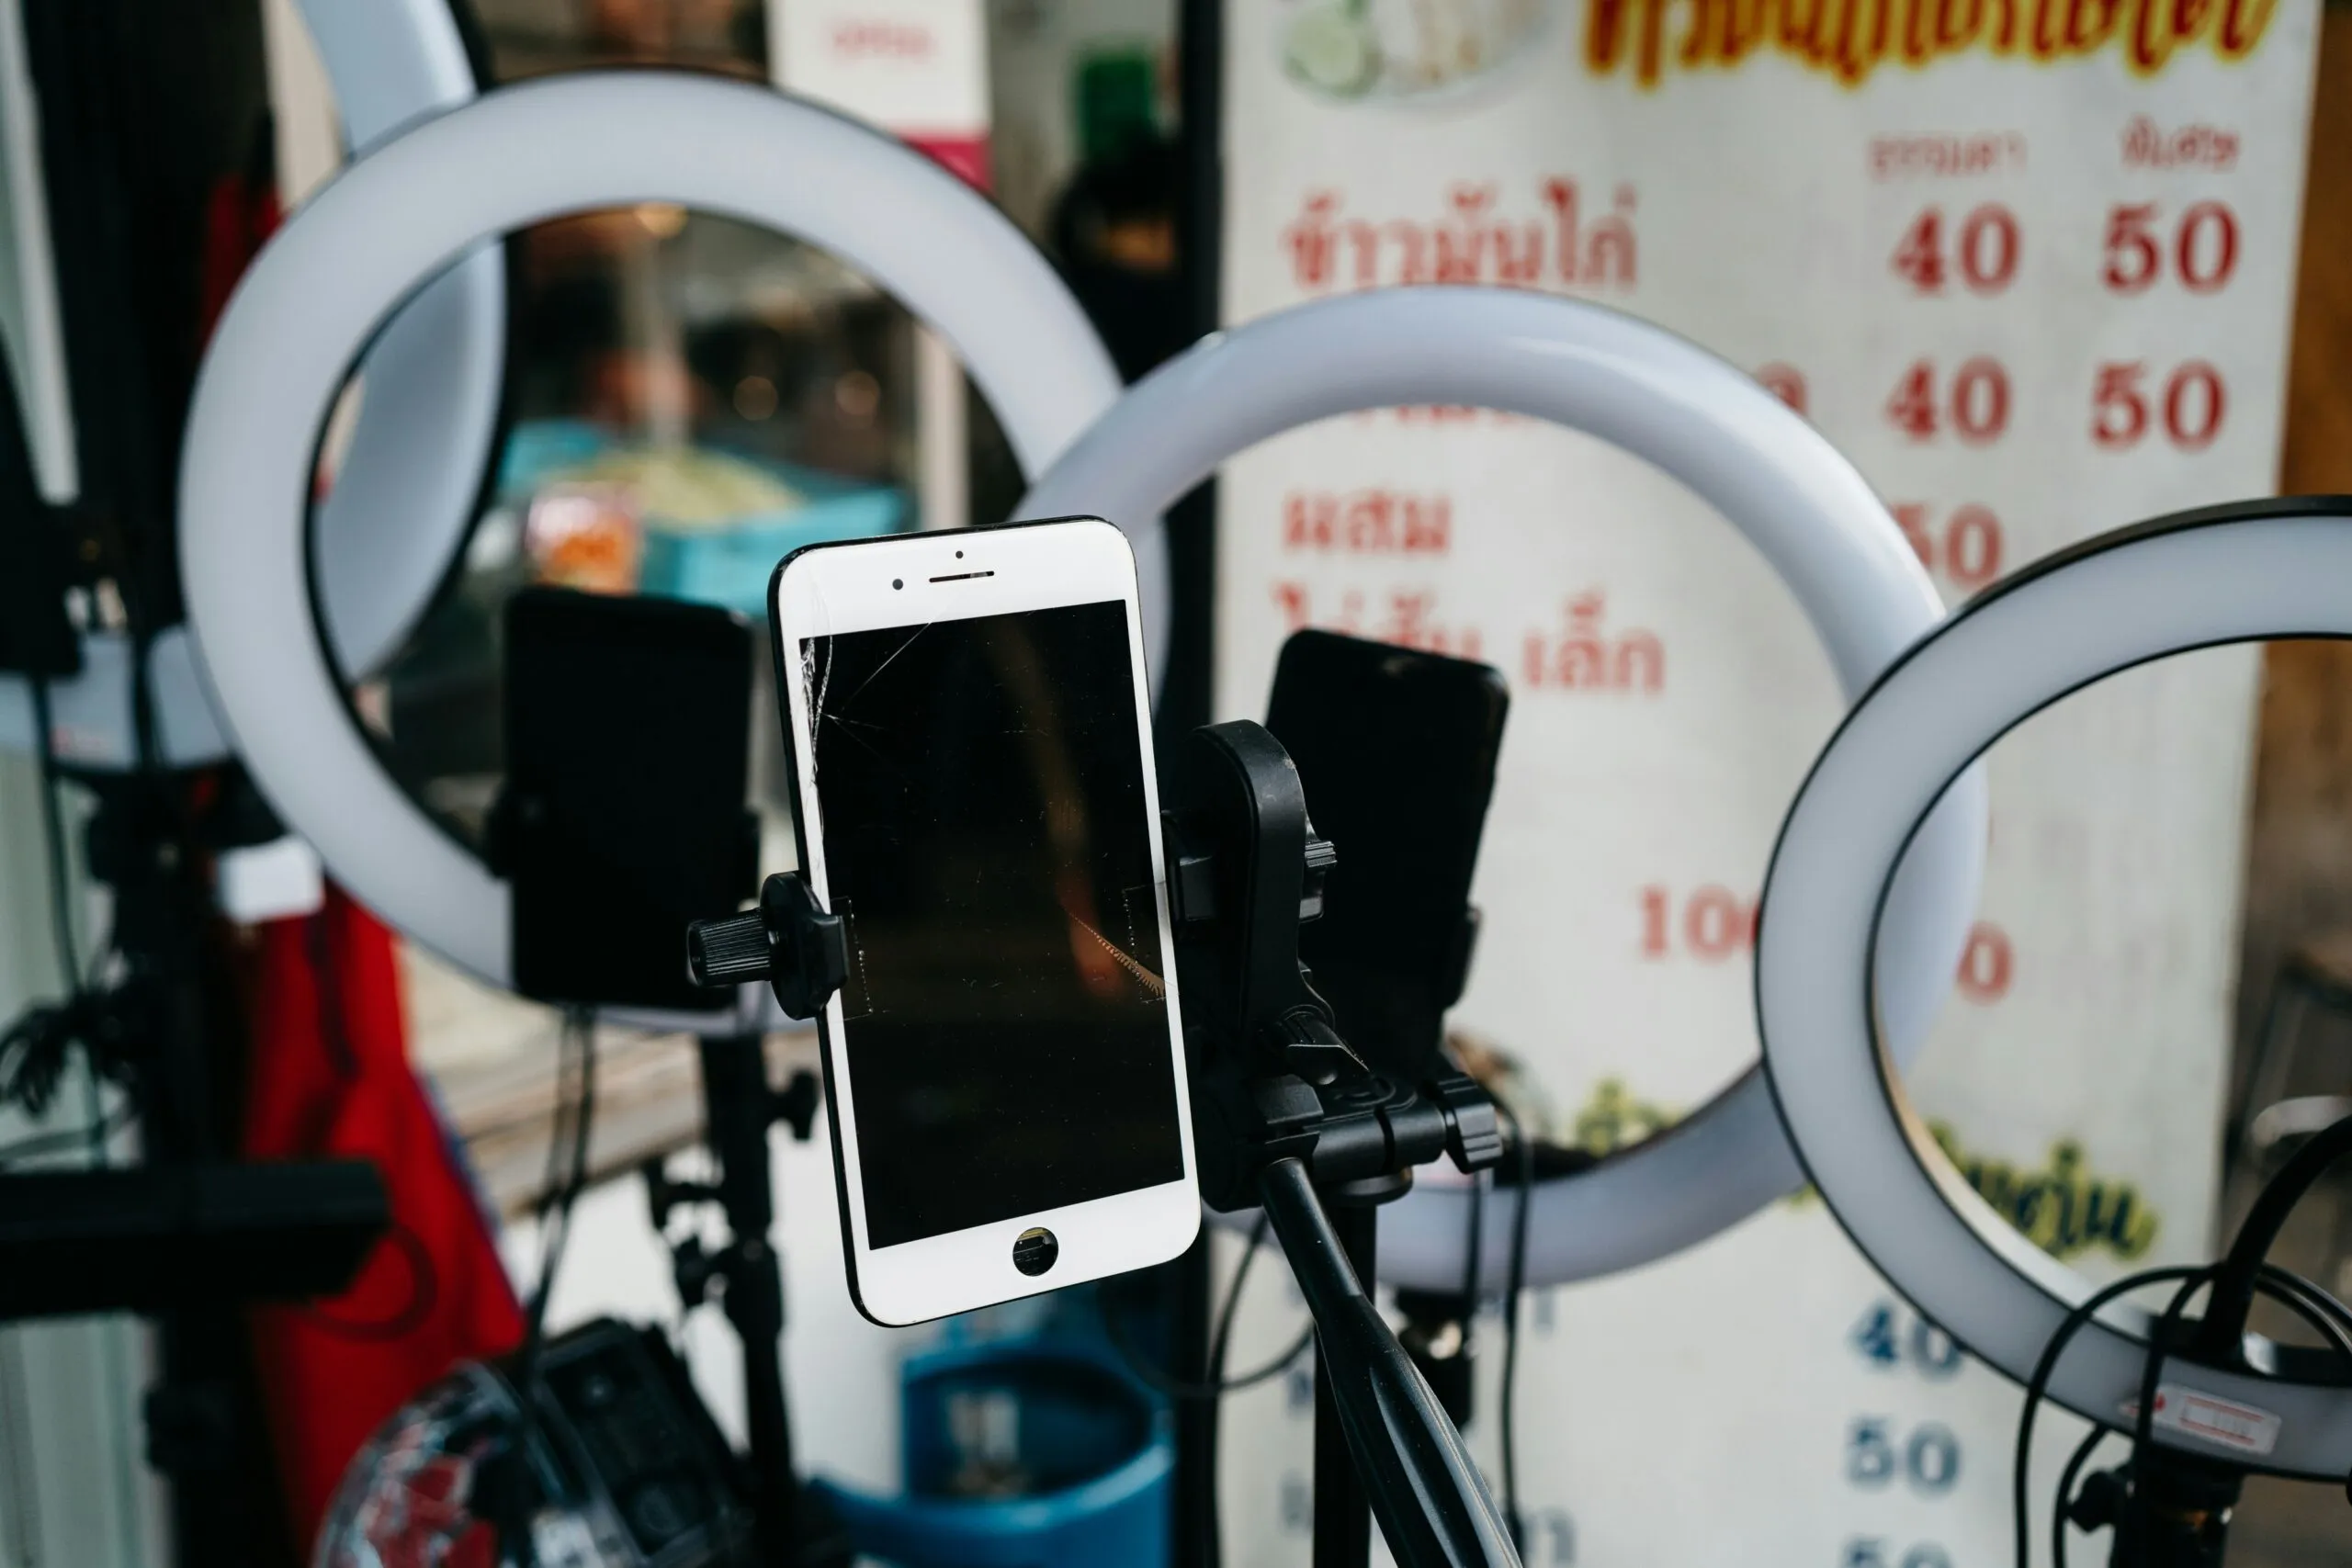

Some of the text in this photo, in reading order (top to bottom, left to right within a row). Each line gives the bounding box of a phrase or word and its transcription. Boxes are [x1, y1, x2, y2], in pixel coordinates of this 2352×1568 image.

[1283, 175, 2240, 296] ข้าวมันไก่ 40 50
[1886, 356, 2012, 445] 40
[2090, 361, 2227, 450] 50
[1640, 886, 1758, 960] 10
[1850, 1300, 1962, 1376] 40
[1848, 1419, 1960, 1492] 50
